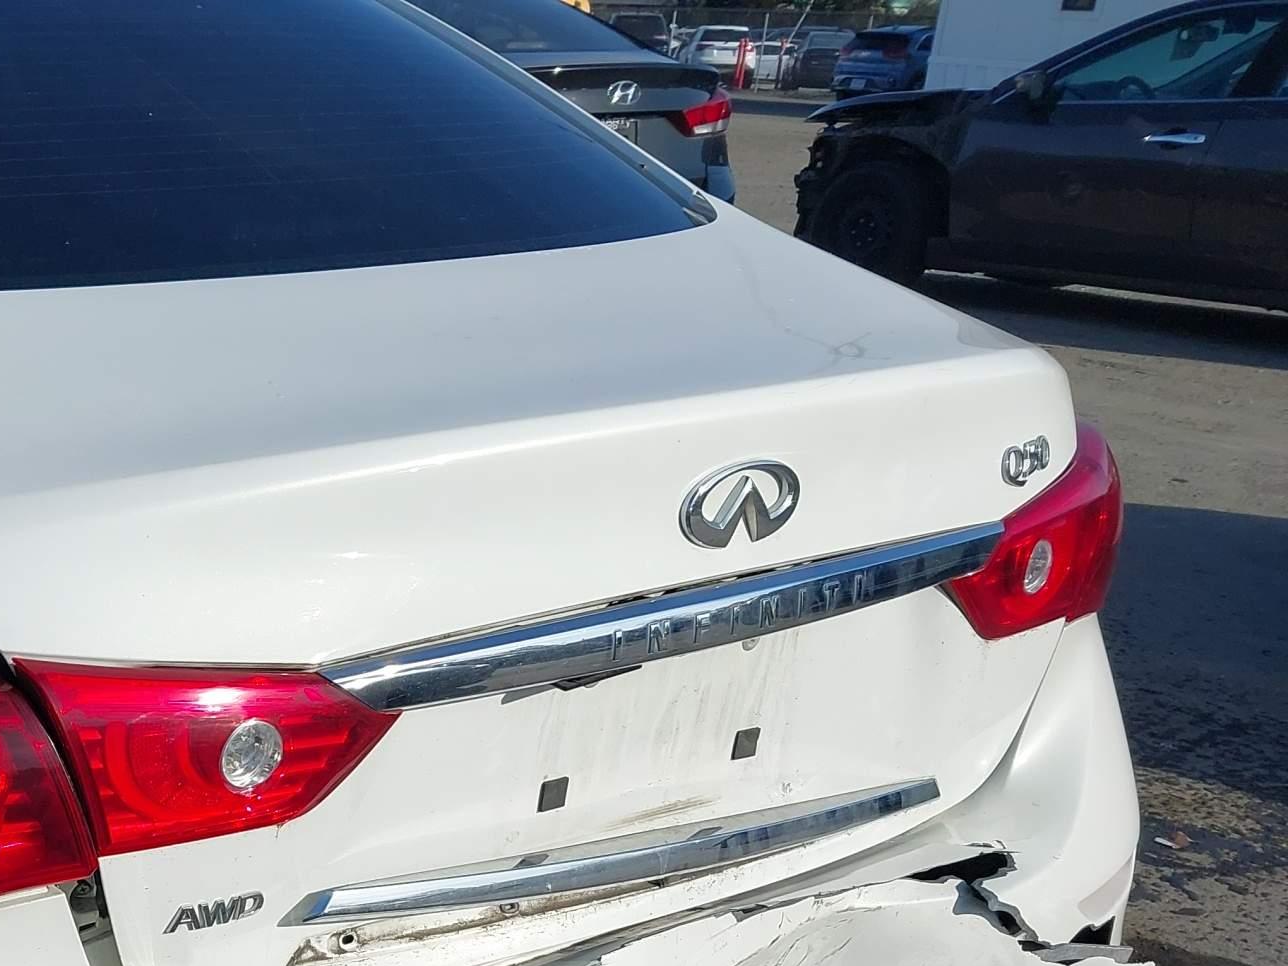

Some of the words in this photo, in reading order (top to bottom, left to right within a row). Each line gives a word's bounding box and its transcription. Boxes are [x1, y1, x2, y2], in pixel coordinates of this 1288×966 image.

[1001, 435, 1050, 487] Q50
[611, 572, 869, 661] INFINITI
[162, 889, 265, 934] AWD
